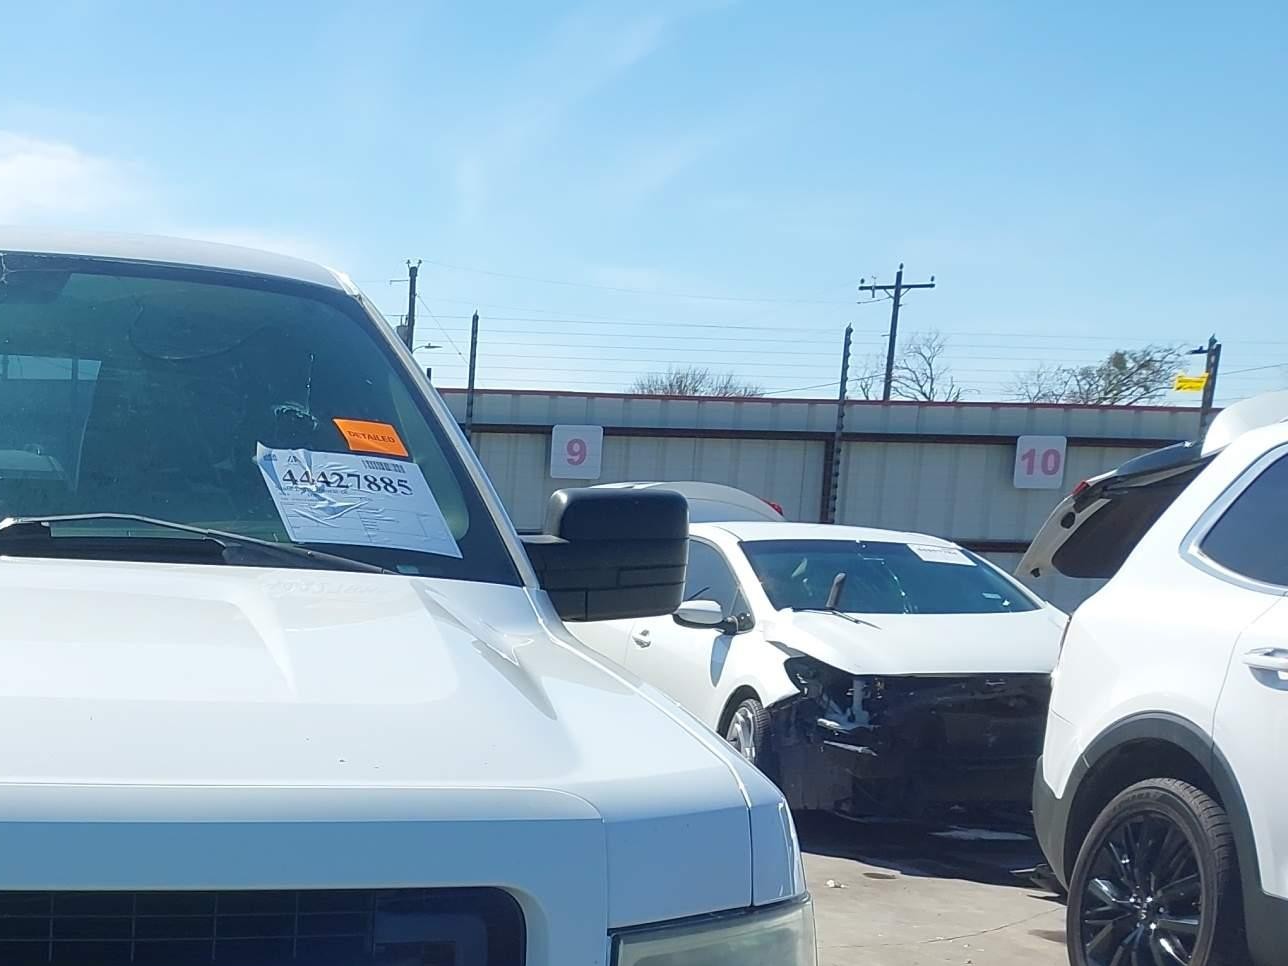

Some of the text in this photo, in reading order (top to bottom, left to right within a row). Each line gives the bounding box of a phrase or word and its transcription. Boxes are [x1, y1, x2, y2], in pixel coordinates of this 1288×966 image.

[346, 430, 396, 444] DETAILED
[567, 438, 587, 466] 9
[1021, 448, 1061, 476] 10
[282, 469, 414, 496] 44427885
